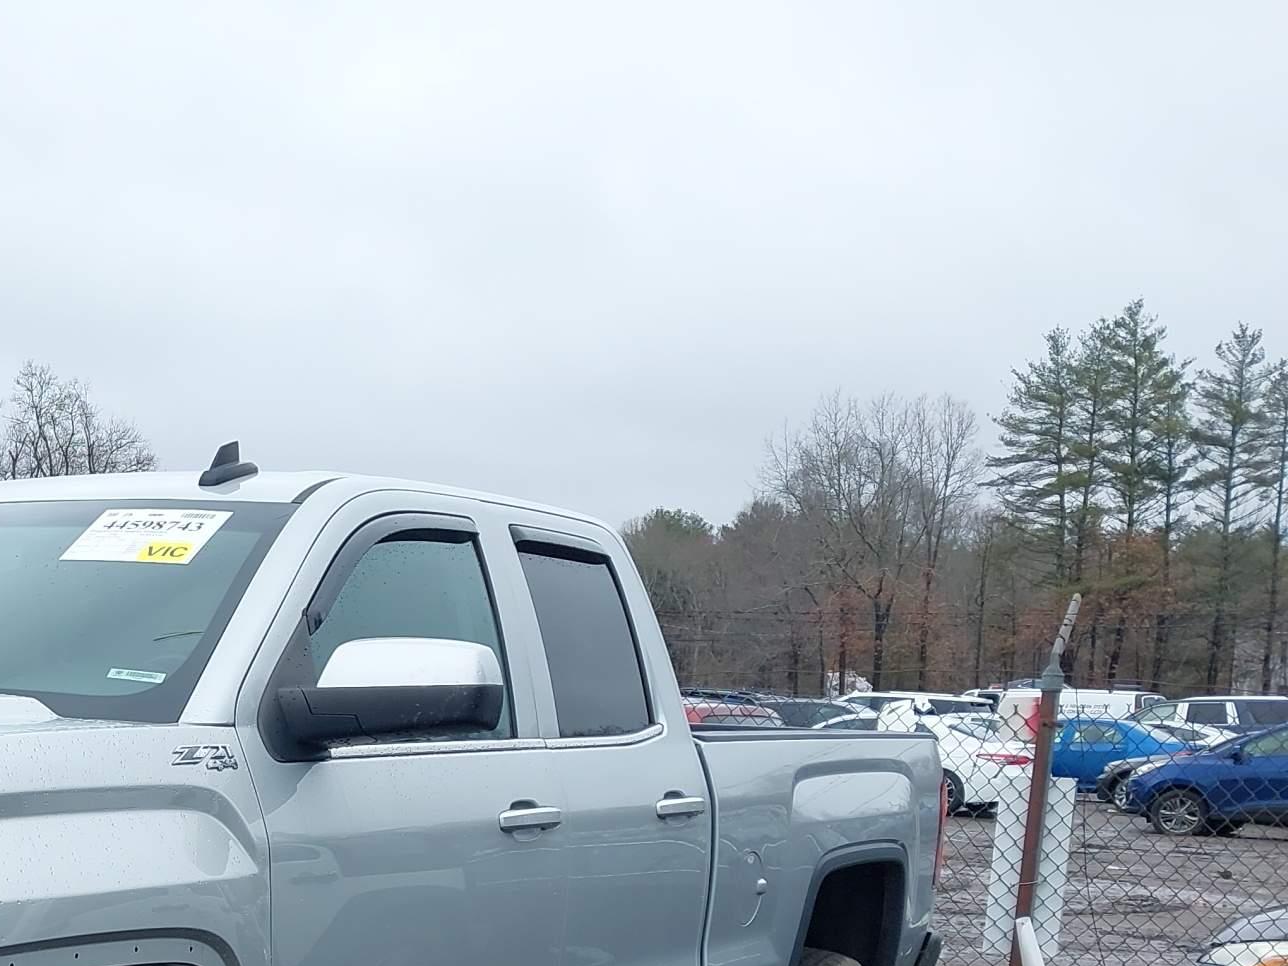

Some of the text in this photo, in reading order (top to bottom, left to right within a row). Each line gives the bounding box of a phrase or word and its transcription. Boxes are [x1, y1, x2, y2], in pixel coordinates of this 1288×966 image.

[104, 520, 204, 532] 44598743
[147, 545, 189, 559] VIC
[171, 745, 234, 766] Z71
